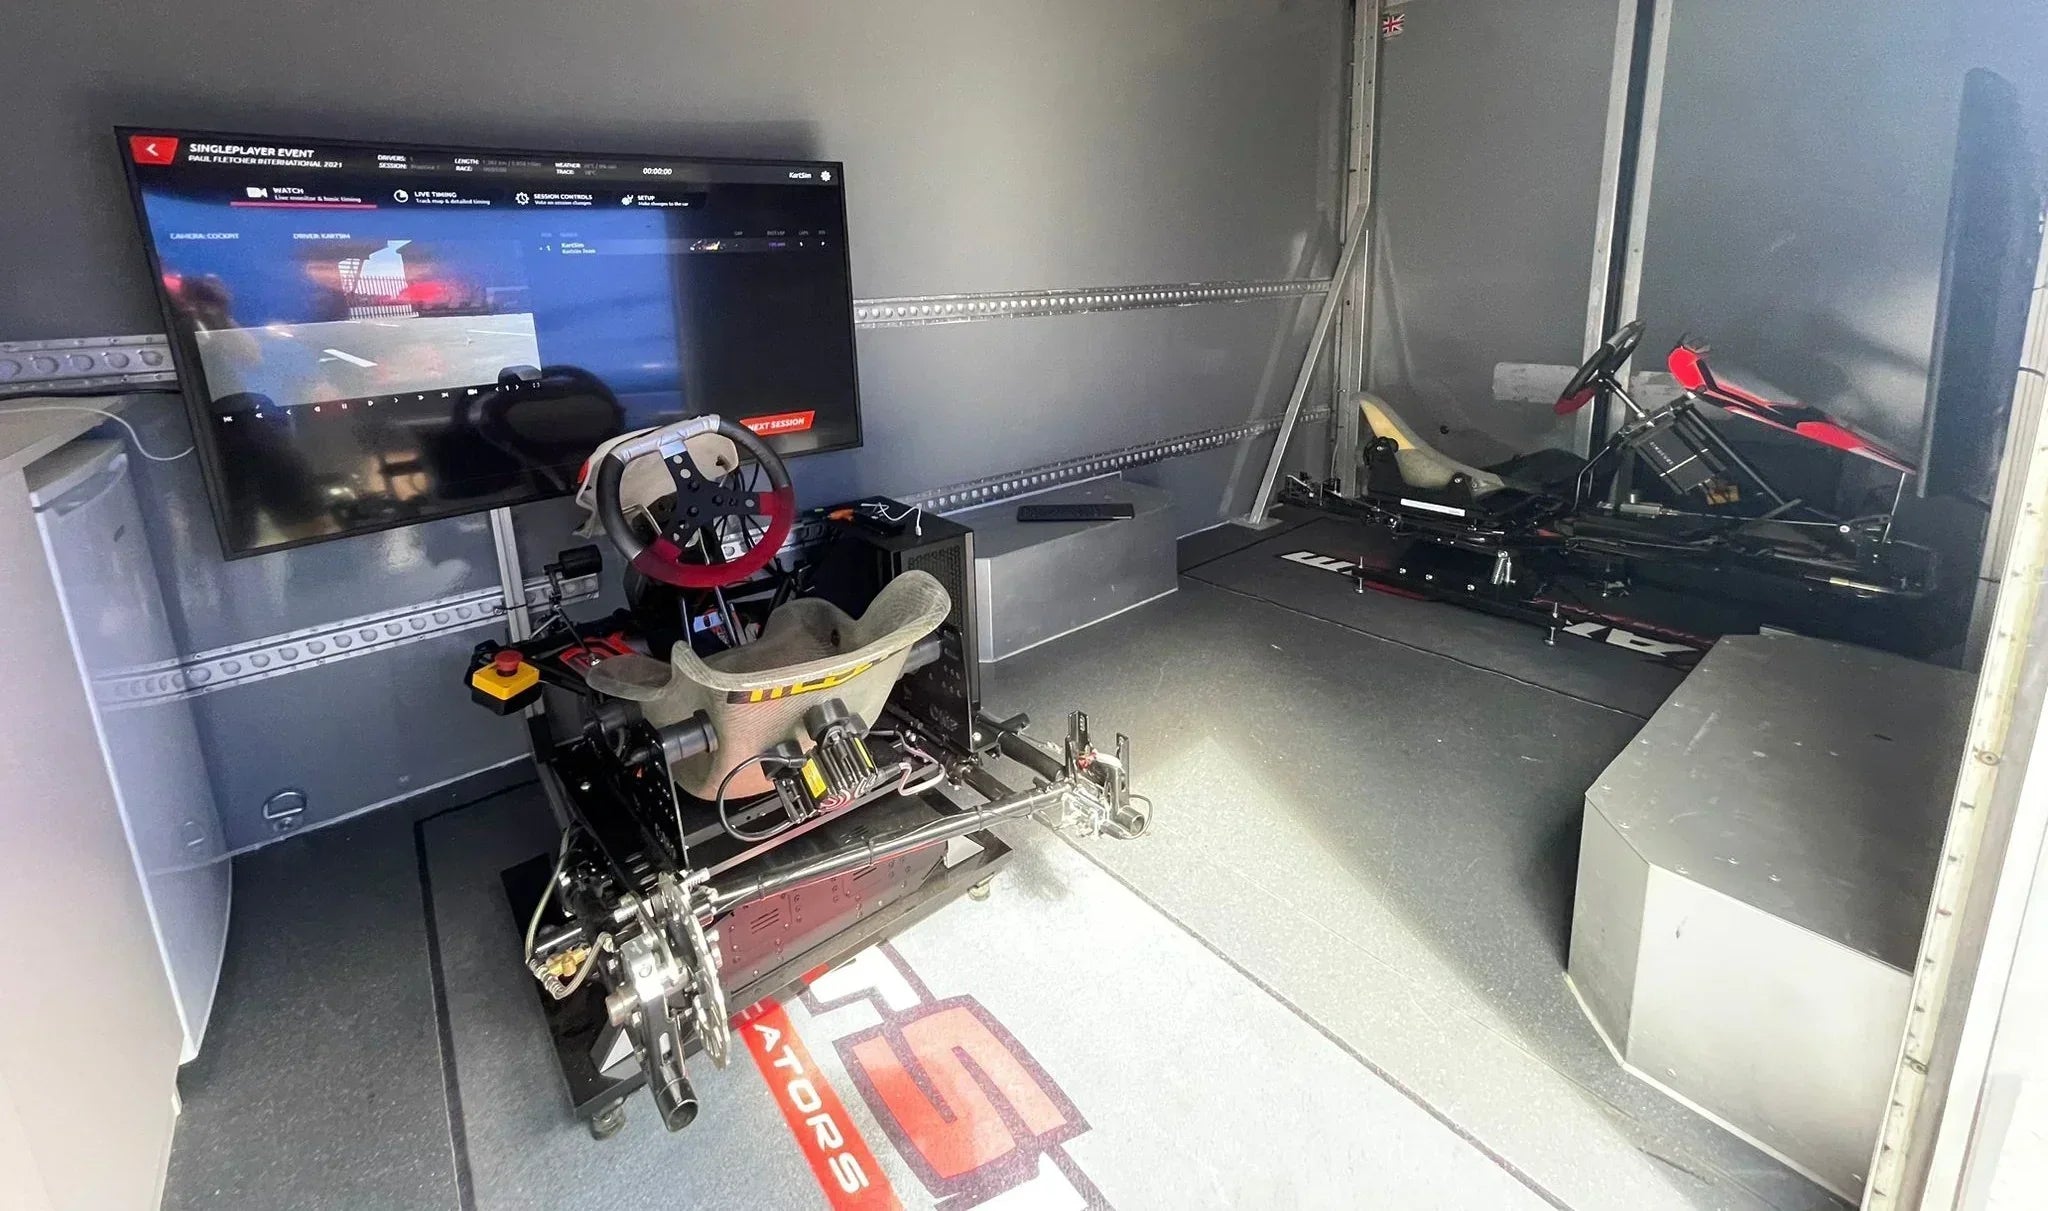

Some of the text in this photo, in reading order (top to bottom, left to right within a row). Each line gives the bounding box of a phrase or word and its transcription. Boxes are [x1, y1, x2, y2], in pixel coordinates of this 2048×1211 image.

[190, 143, 315, 158] SINGLEPLAYER EVENT
[188, 155, 343, 169] PAUL FLETCHER INTERNATIONAL 2021
[642, 167, 673, 175] 00:00:00
[748, 417, 805, 431] NEXT SESSION
